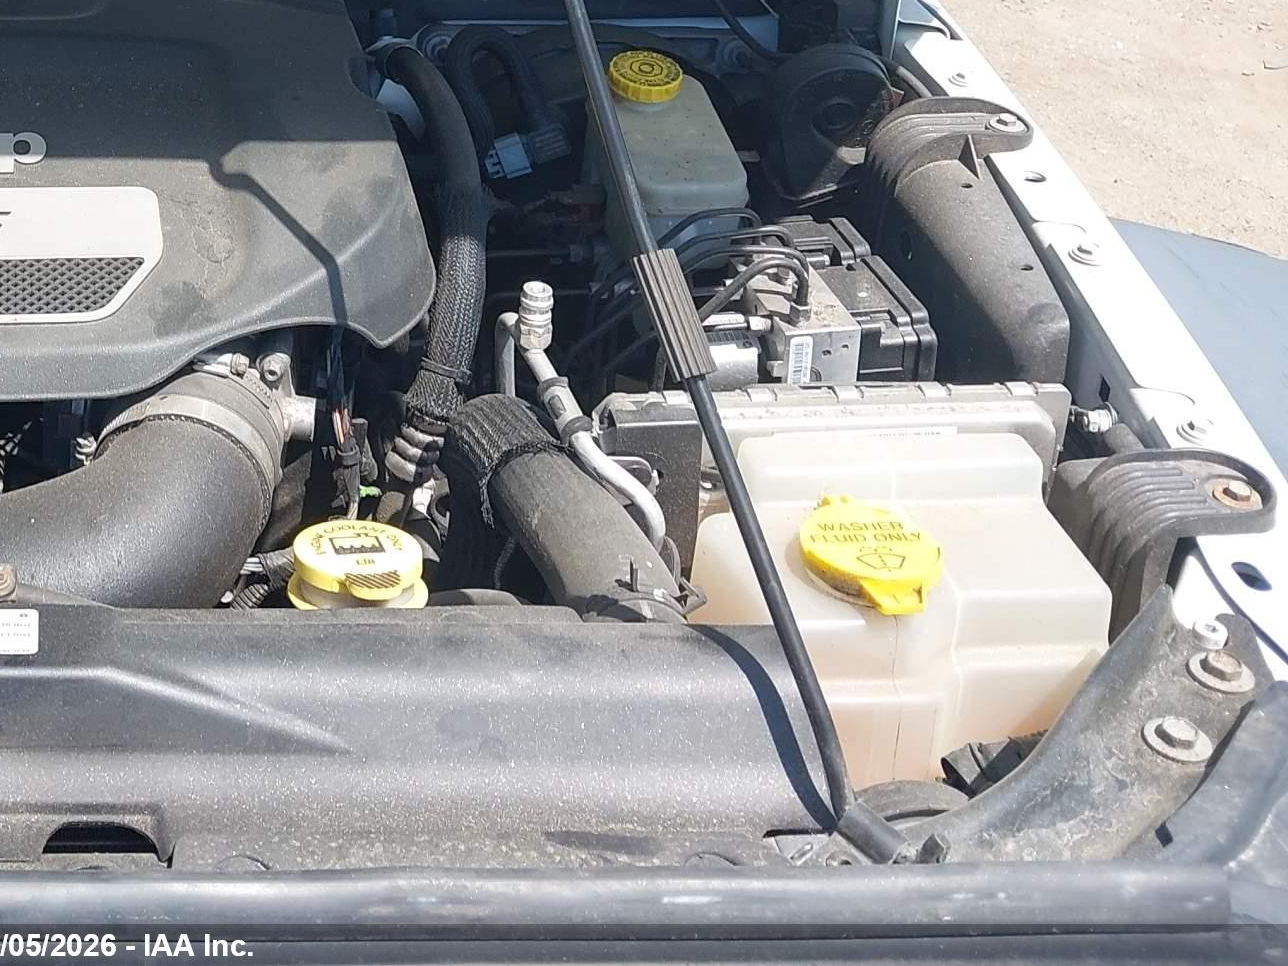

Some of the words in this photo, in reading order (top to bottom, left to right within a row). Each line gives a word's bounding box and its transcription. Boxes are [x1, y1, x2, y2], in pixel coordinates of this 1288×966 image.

[324, 525, 387, 534] COOLANT
[817, 521, 904, 532] WASHER
[810, 533, 867, 543] FLUID
[873, 532, 921, 543] ONLY
